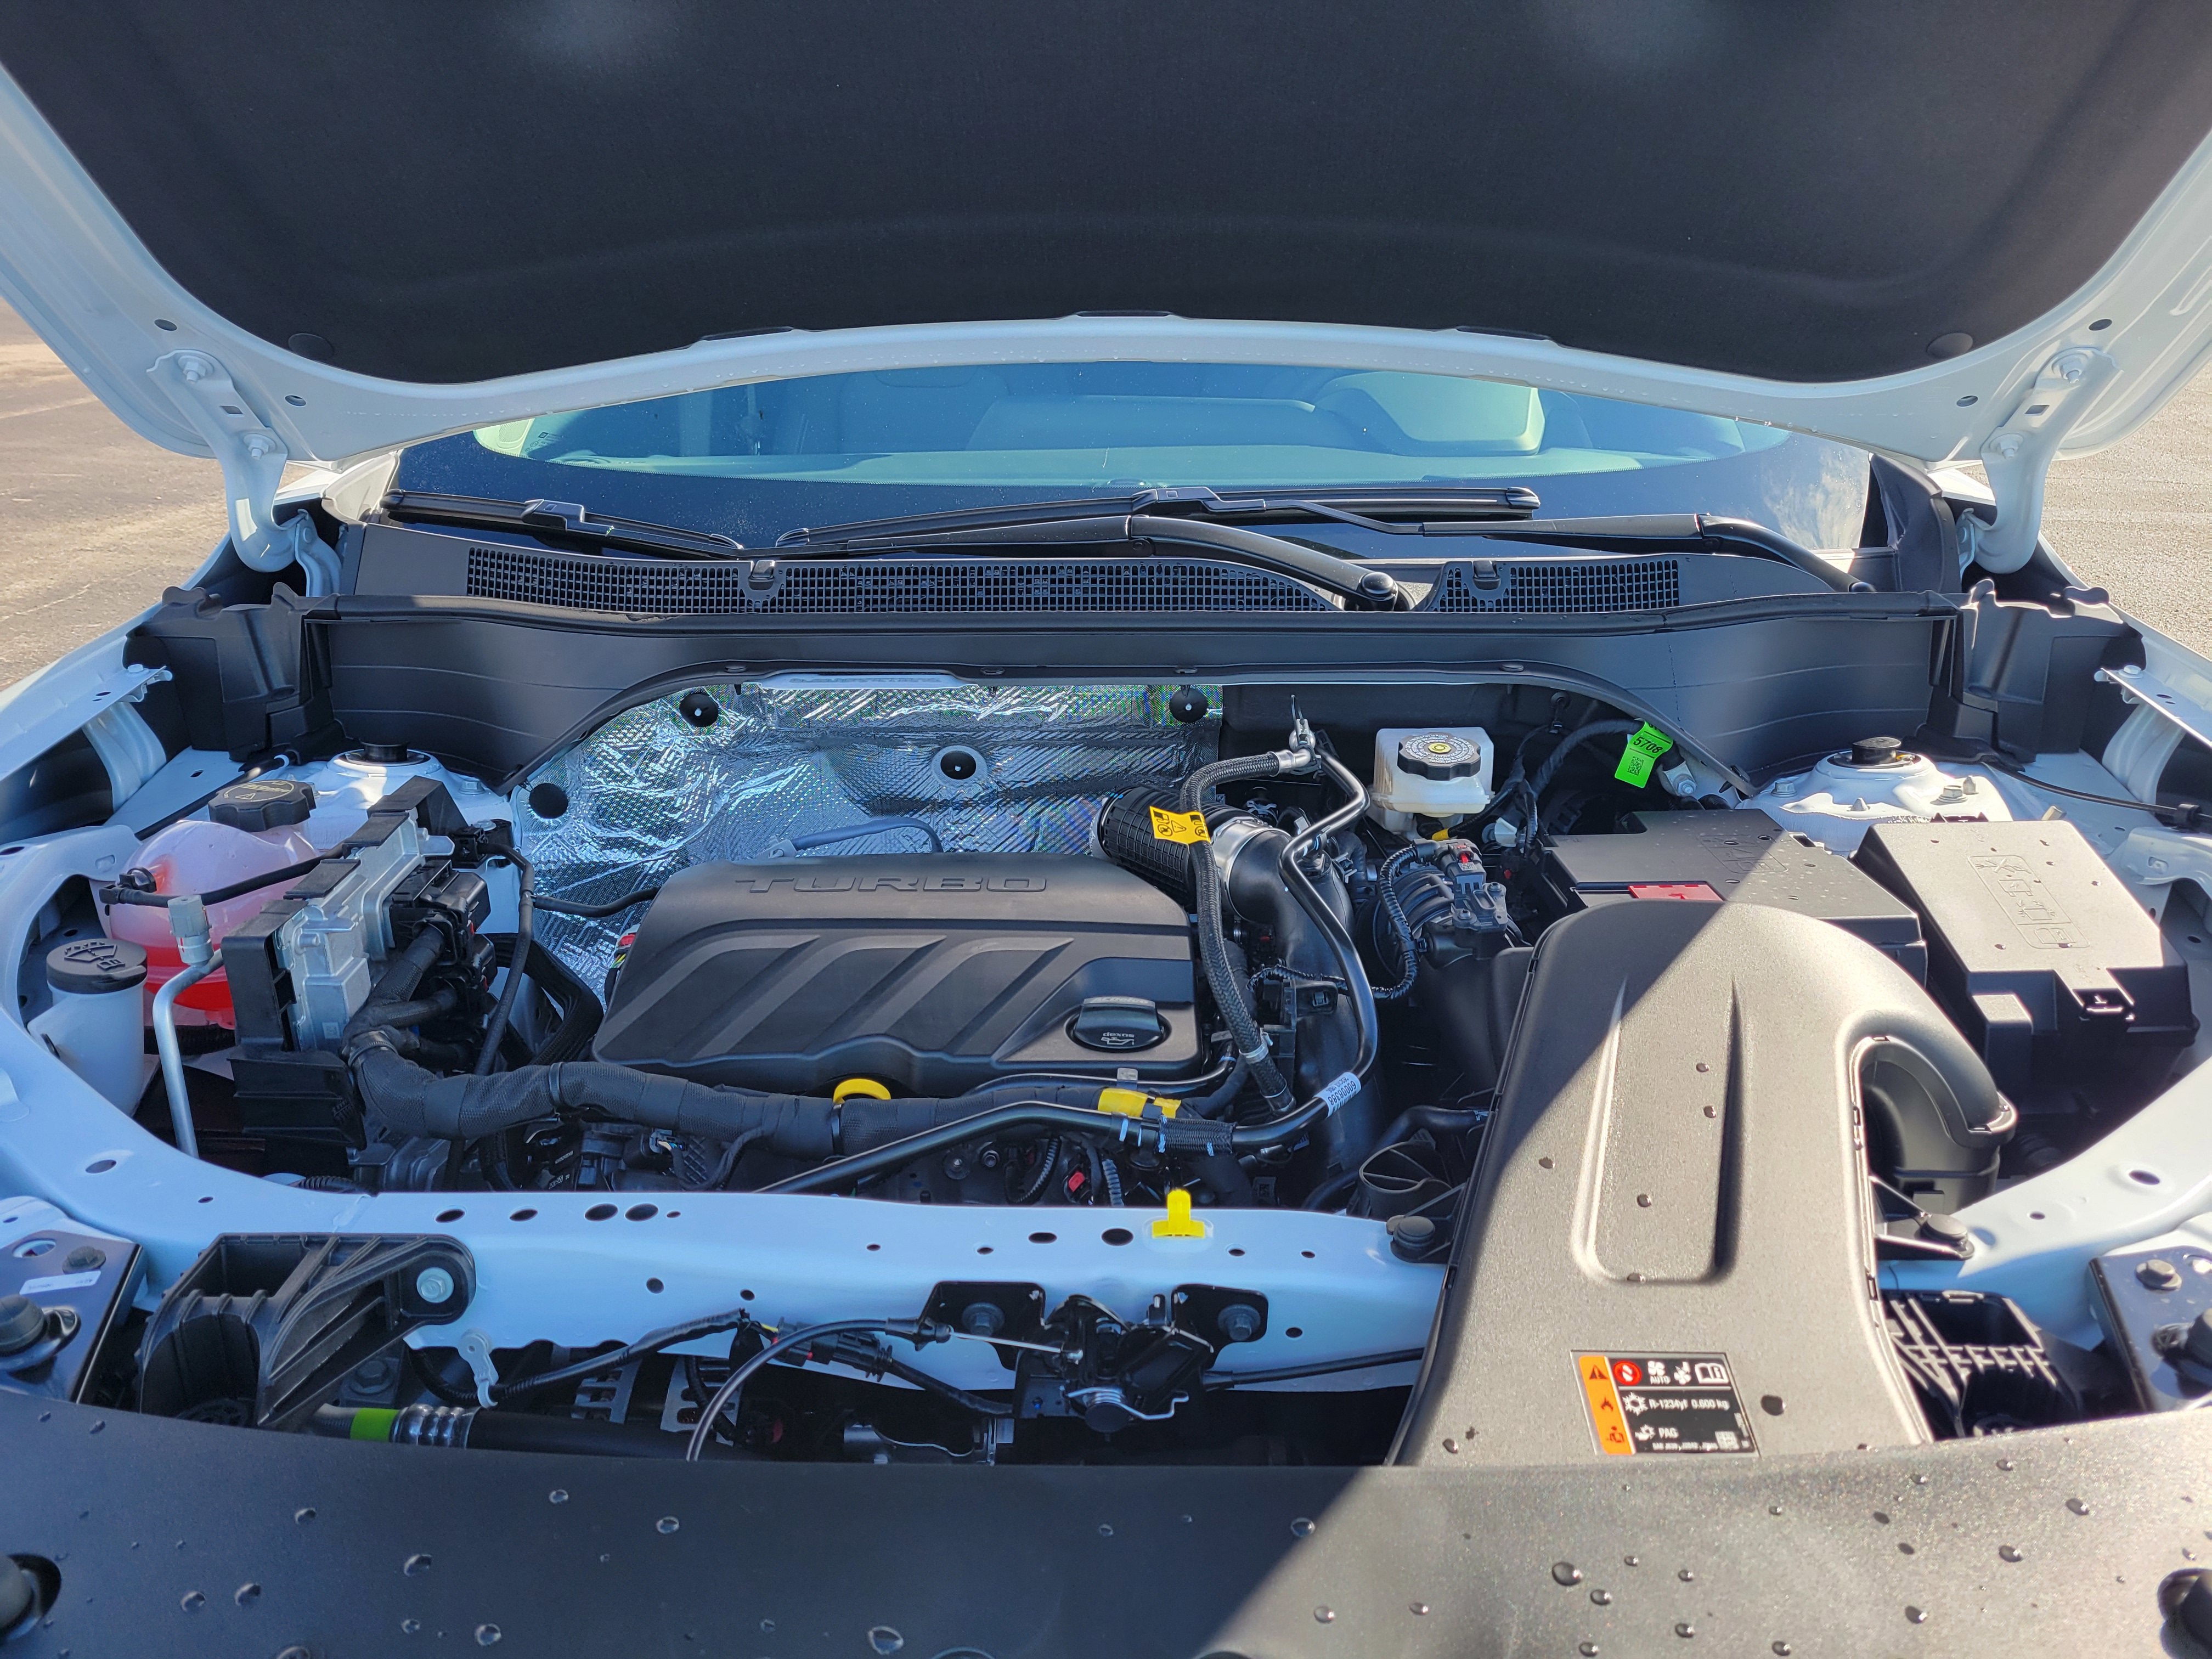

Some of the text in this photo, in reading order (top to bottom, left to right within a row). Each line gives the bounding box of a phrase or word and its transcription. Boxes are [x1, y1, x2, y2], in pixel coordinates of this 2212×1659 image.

[1633, 736, 1663, 753] 5708
[735, 877, 1047, 893] TURBO
[1328, 1081, 1357, 1105] 60008388
[1650, 1376, 1671, 1385] AUTO
[1649, 1399, 1730, 1410] R-1234yf 0.600 kg
[1658, 1427, 1679, 1438] PAG
